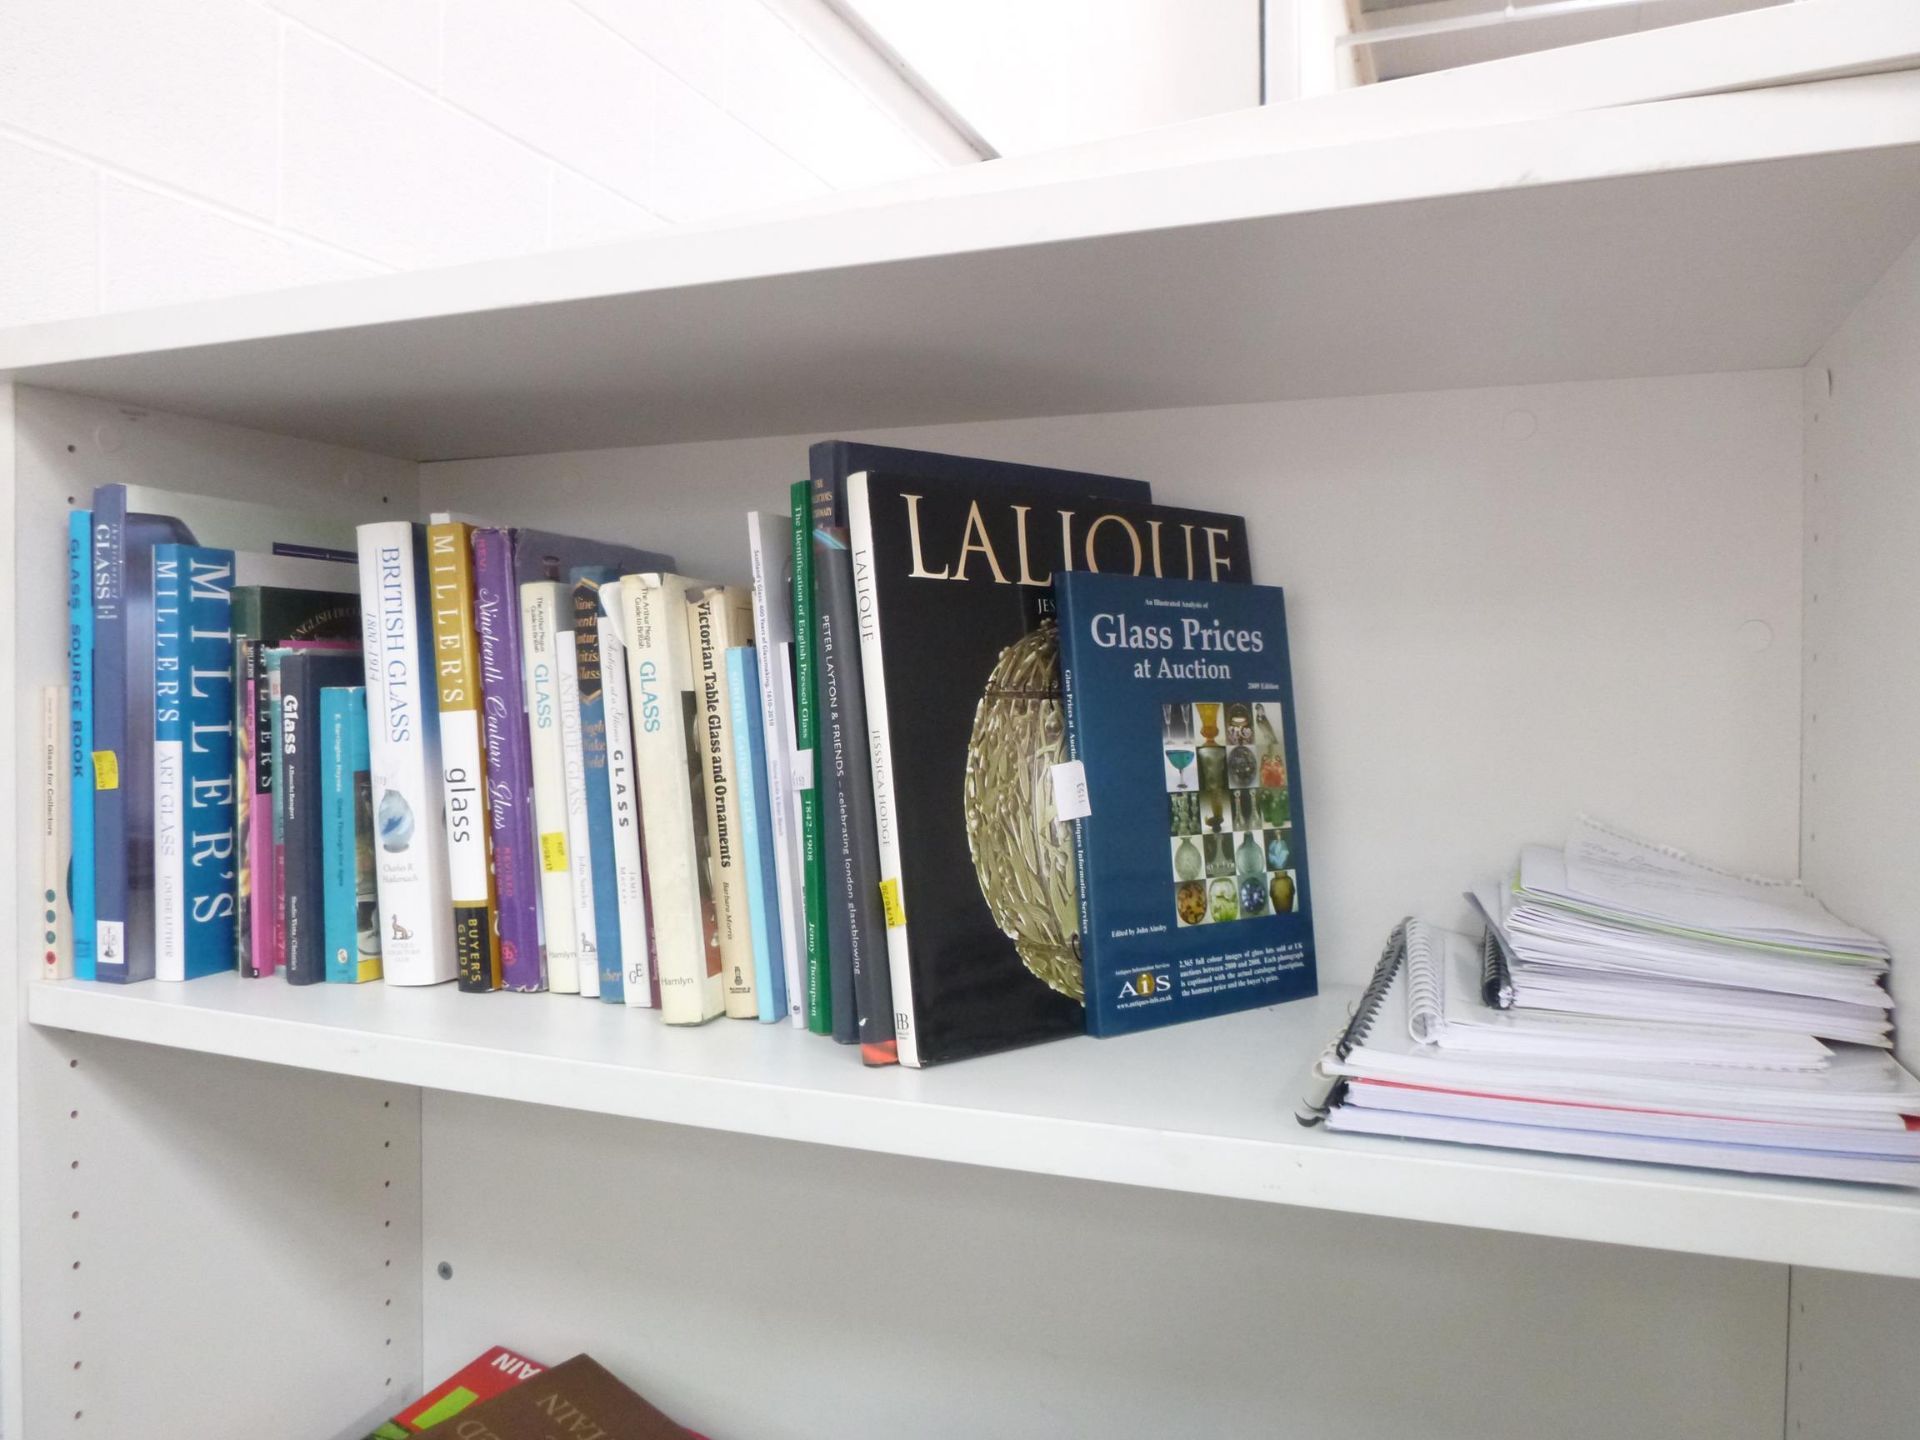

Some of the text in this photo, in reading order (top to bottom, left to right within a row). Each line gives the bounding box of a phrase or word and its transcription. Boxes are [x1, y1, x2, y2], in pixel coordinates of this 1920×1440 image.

[95, 524, 111, 599] GLASS
[855, 549, 874, 643] LALIQUE
[157, 561, 179, 721] MILLER'S
[382, 547, 410, 743] BRITISH GLASS
[433, 535, 464, 703] MILLER'S
[795, 505, 810, 739] The Identification of English Pressed Glass
[1090, 612, 1264, 652] Glass Prices
[70, 539, 84, 778] GLASS SOURCE BOOK
[534, 664, 552, 728] GLASS
[1064, 669, 1072, 691] Glass
[1133, 656, 1232, 679] at Auction
[283, 695, 299, 754] Glass
[478, 588, 513, 830] Nineteenth Century Glass
[639, 661, 660, 733] GLASS
[697, 601, 733, 868] Victorian Table Glass and Ornaments
[1066, 693, 1074, 718] Prices
[190, 557, 234, 923] MILLER'S
[159, 752, 175, 856] ART GLASS
[445, 768, 476, 843] glass
[565, 760, 583, 815] GLASS
[614, 750, 629, 828] GLASS
[821, 615, 862, 975] PETER LAYTON & FRIENDS celebrating london glassblowing
[878, 794, 890, 847] HODGE
[722, 881, 731, 912] Barbara
[1075, 818, 1089, 934] ntiques Information Services
[457, 924, 468, 977] GUIDE
[468, 919, 481, 983] BUYER'S
[808, 921, 818, 1017] Jenny Thompson
[491, 1352, 543, 1380] AIN
